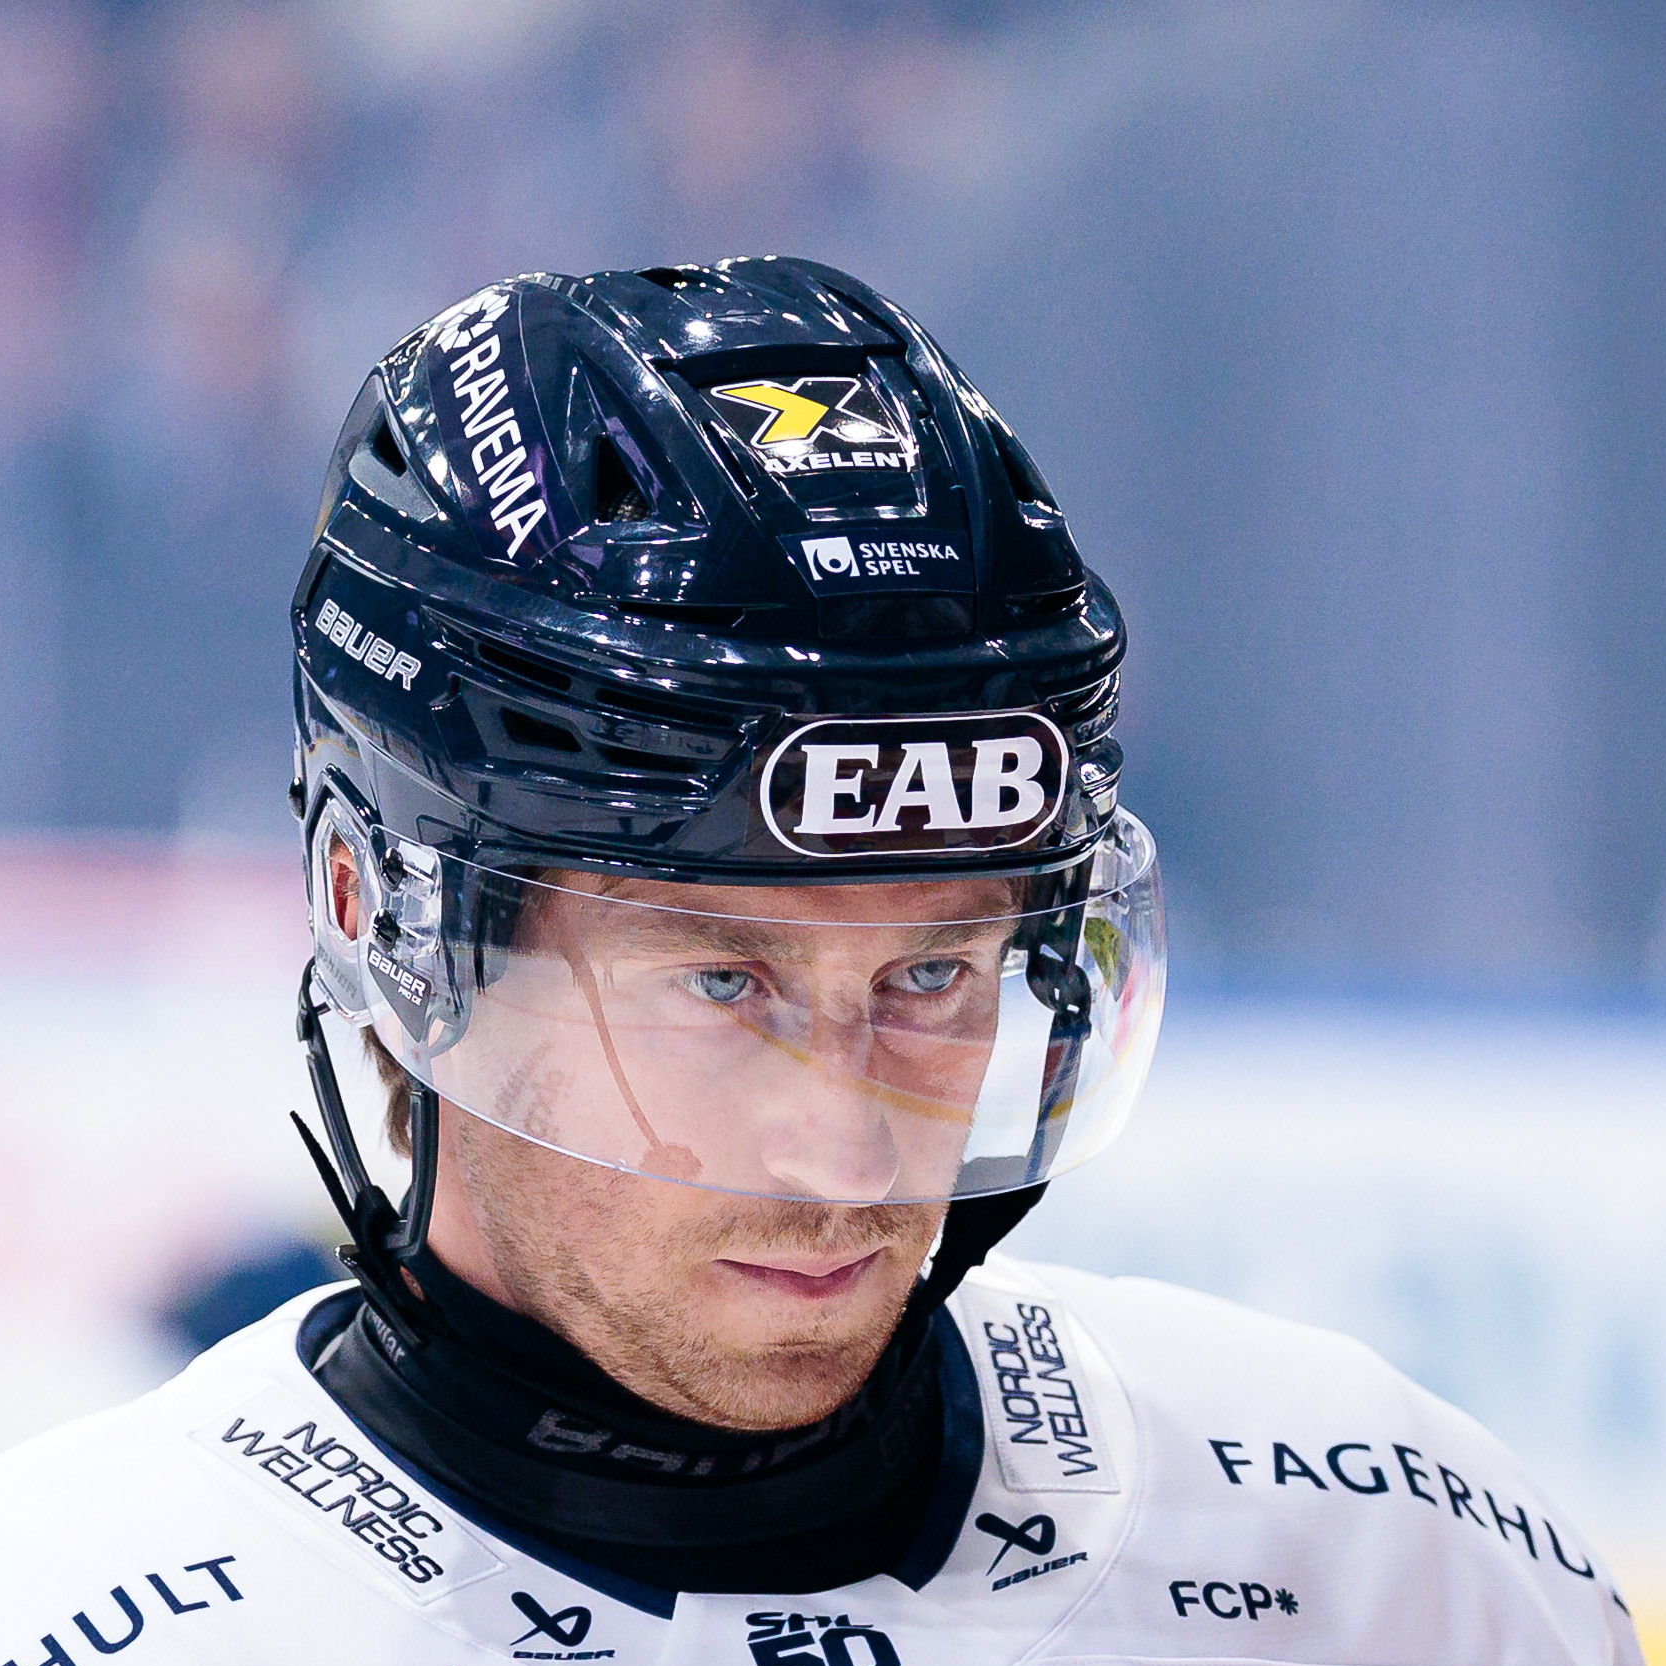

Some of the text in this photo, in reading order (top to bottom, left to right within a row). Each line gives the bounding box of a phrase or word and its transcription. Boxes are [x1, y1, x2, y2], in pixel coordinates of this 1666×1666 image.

[448, 333, 547, 560] RAVEMA
[763, 450, 920, 474] AXELENT
[858, 542, 961, 562] SVENSKA
[863, 560, 921, 577] SPEL
[314, 598, 422, 691] BAUER
[794, 735, 1045, 833] EAB
[367, 949, 427, 996] BAUER
[984, 1321, 1048, 1445] NORDIC
[1017, 1302, 1098, 1477] WELLNESS
[221, 1417, 444, 1584] WELLNESS
[282, 1420, 443, 1539] NORDIC
[991, 1551, 1089, 1592] BAUER
[1206, 1437, 1631, 1618] FAGERHU
[512, 1649, 616, 1661] BAUER
